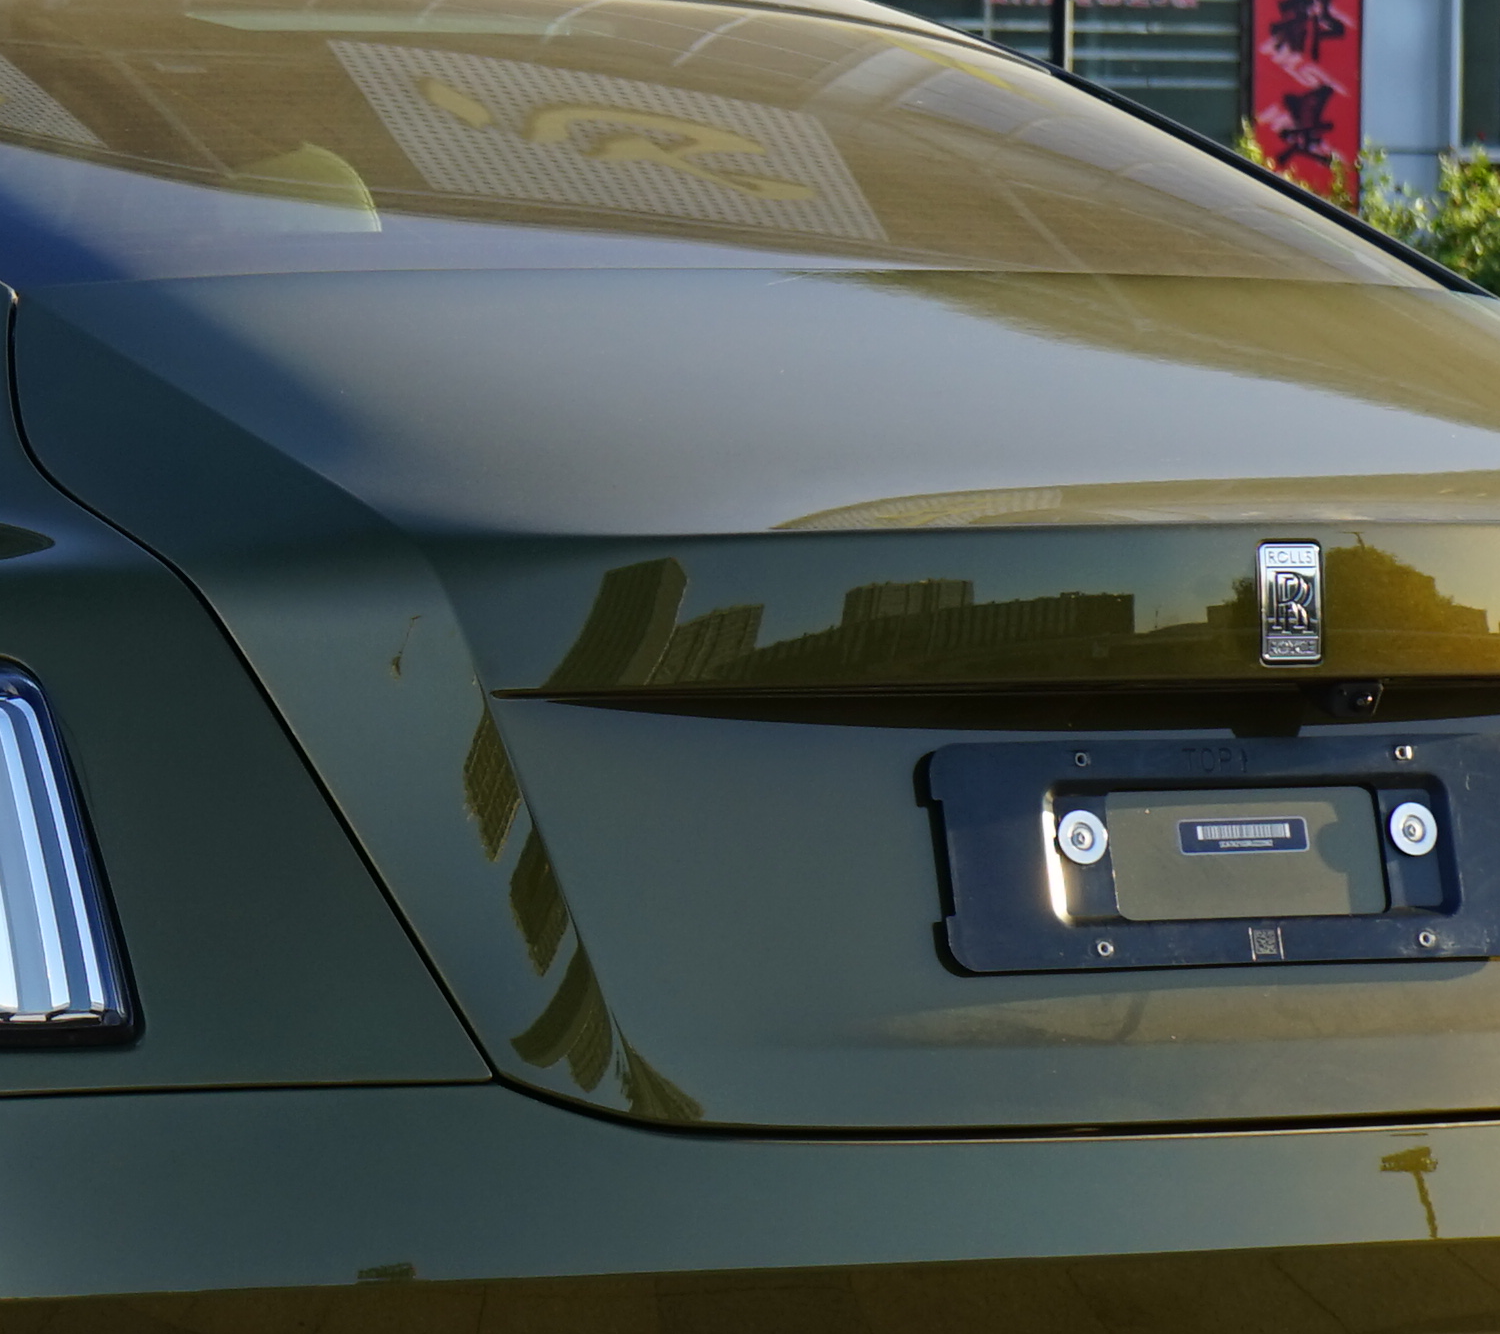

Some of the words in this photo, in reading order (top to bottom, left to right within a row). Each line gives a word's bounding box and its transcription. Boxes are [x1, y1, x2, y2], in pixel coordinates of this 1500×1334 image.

[1266, 549, 1315, 565] ROLLS
[1268, 639, 1317, 656] ROYCE
[1180, 746, 1234, 774] TOP
